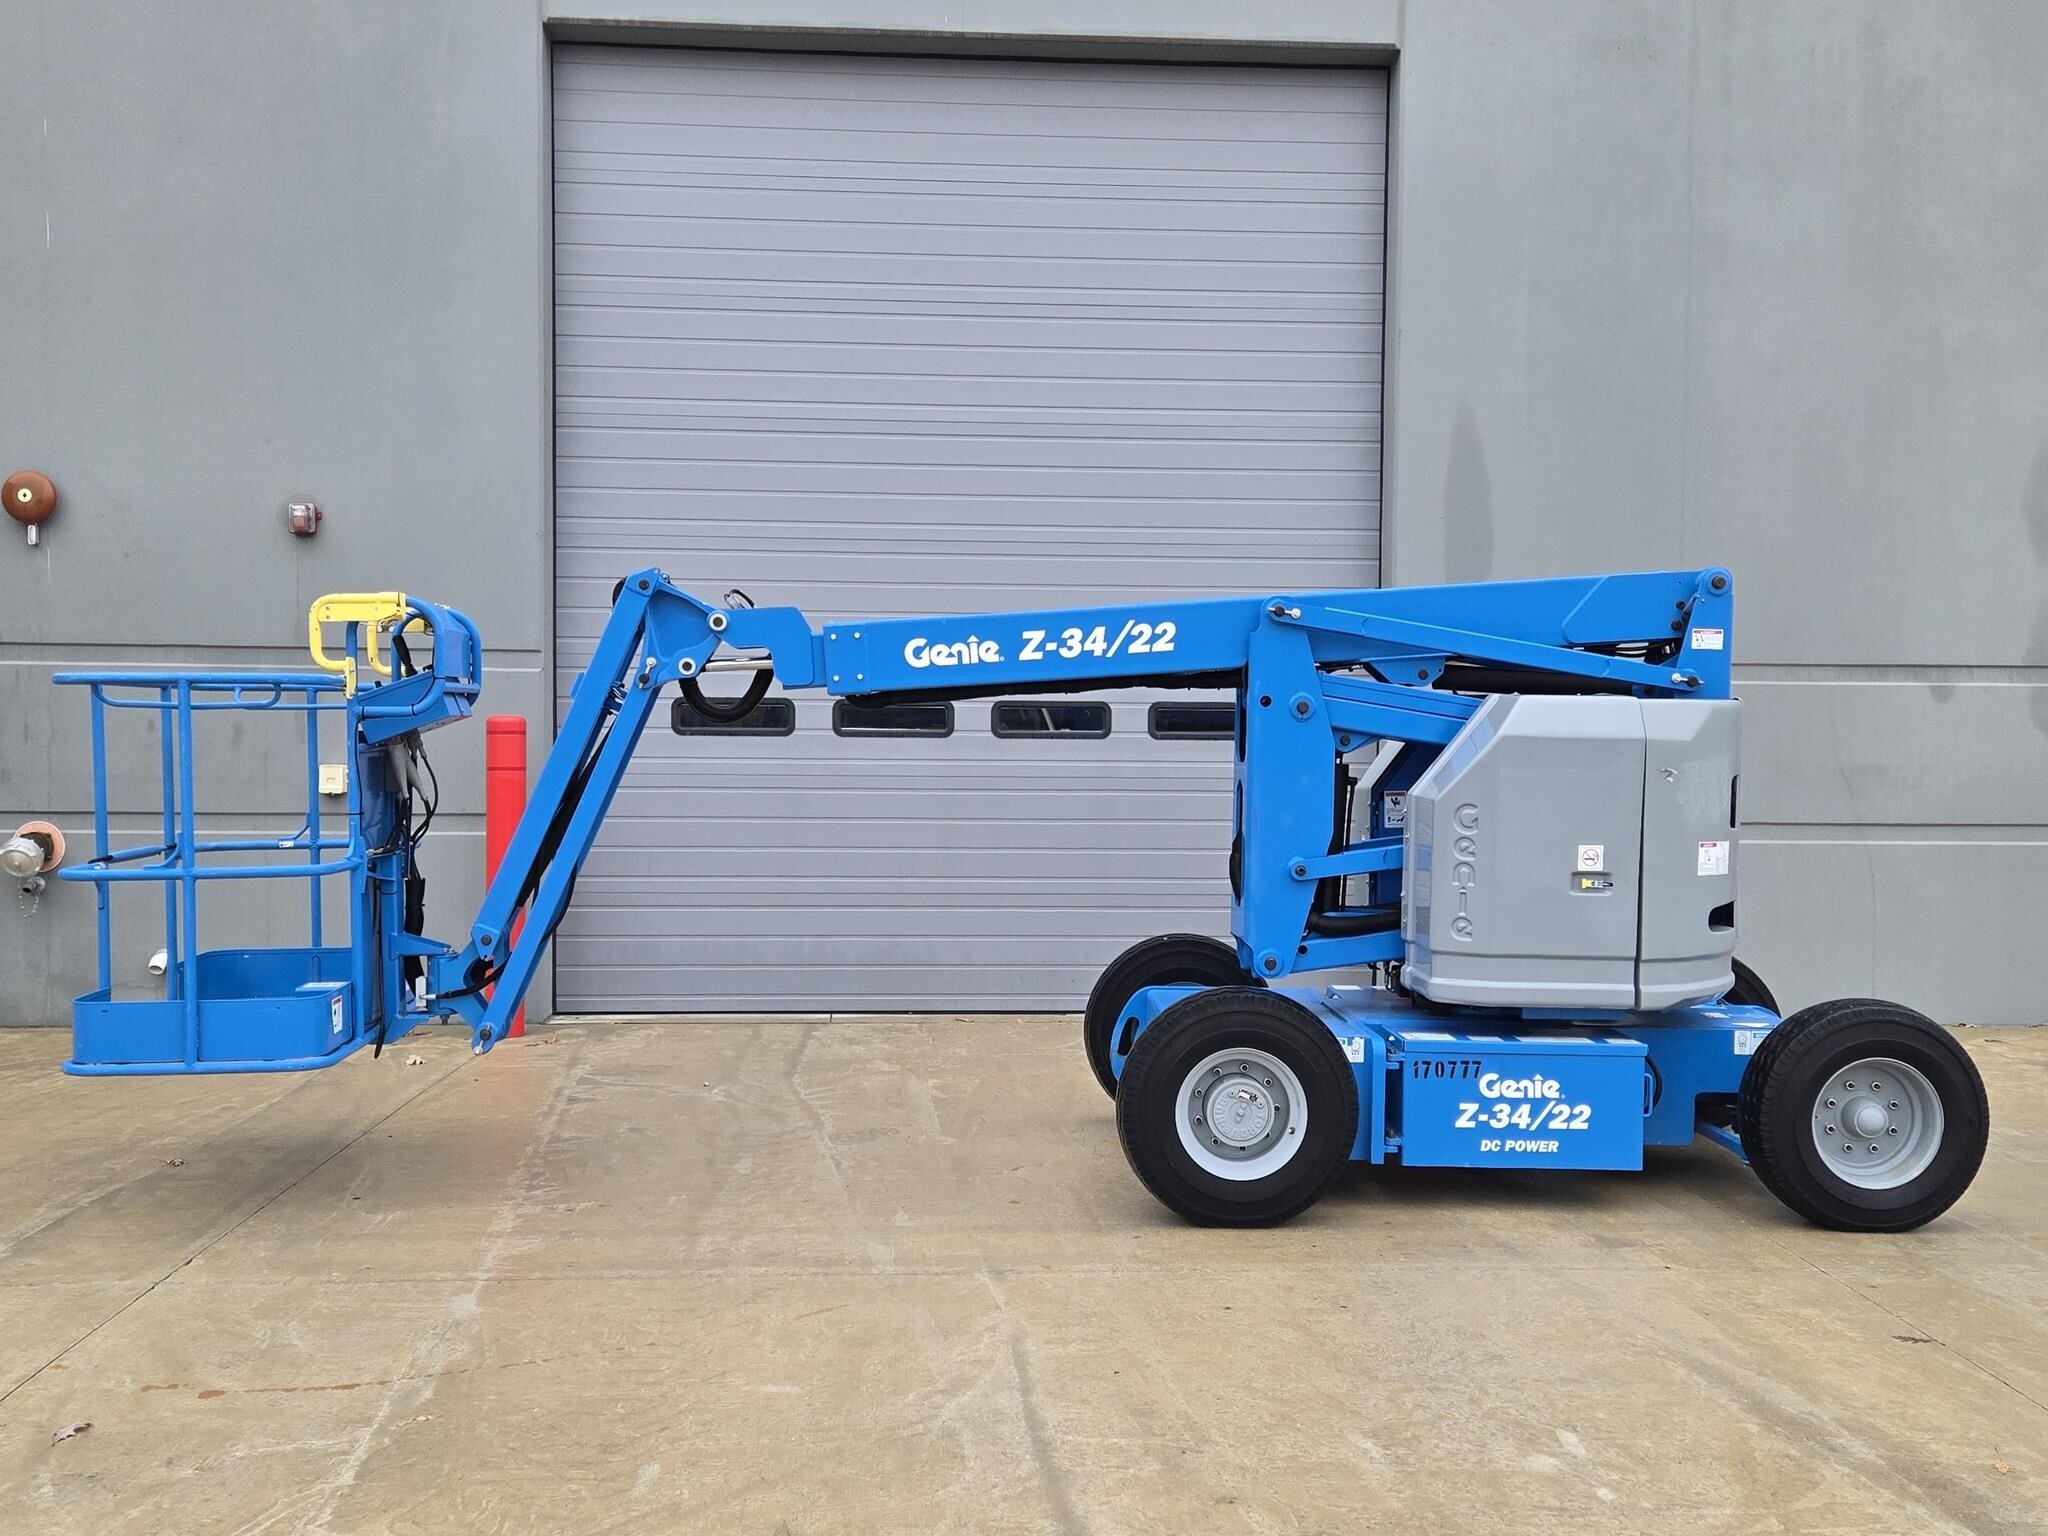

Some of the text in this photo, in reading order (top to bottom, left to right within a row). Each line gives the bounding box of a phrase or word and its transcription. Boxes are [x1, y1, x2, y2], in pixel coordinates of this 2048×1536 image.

[904, 619, 1177, 668] Genie Z-34/22
[1451, 802, 1478, 942] Genie
[1413, 1060, 1482, 1080] 170777
[1478, 1072, 1562, 1099] Genie
[1454, 1100, 1592, 1131] Z-34/22
[1480, 1139, 1560, 1153] DC POWER
